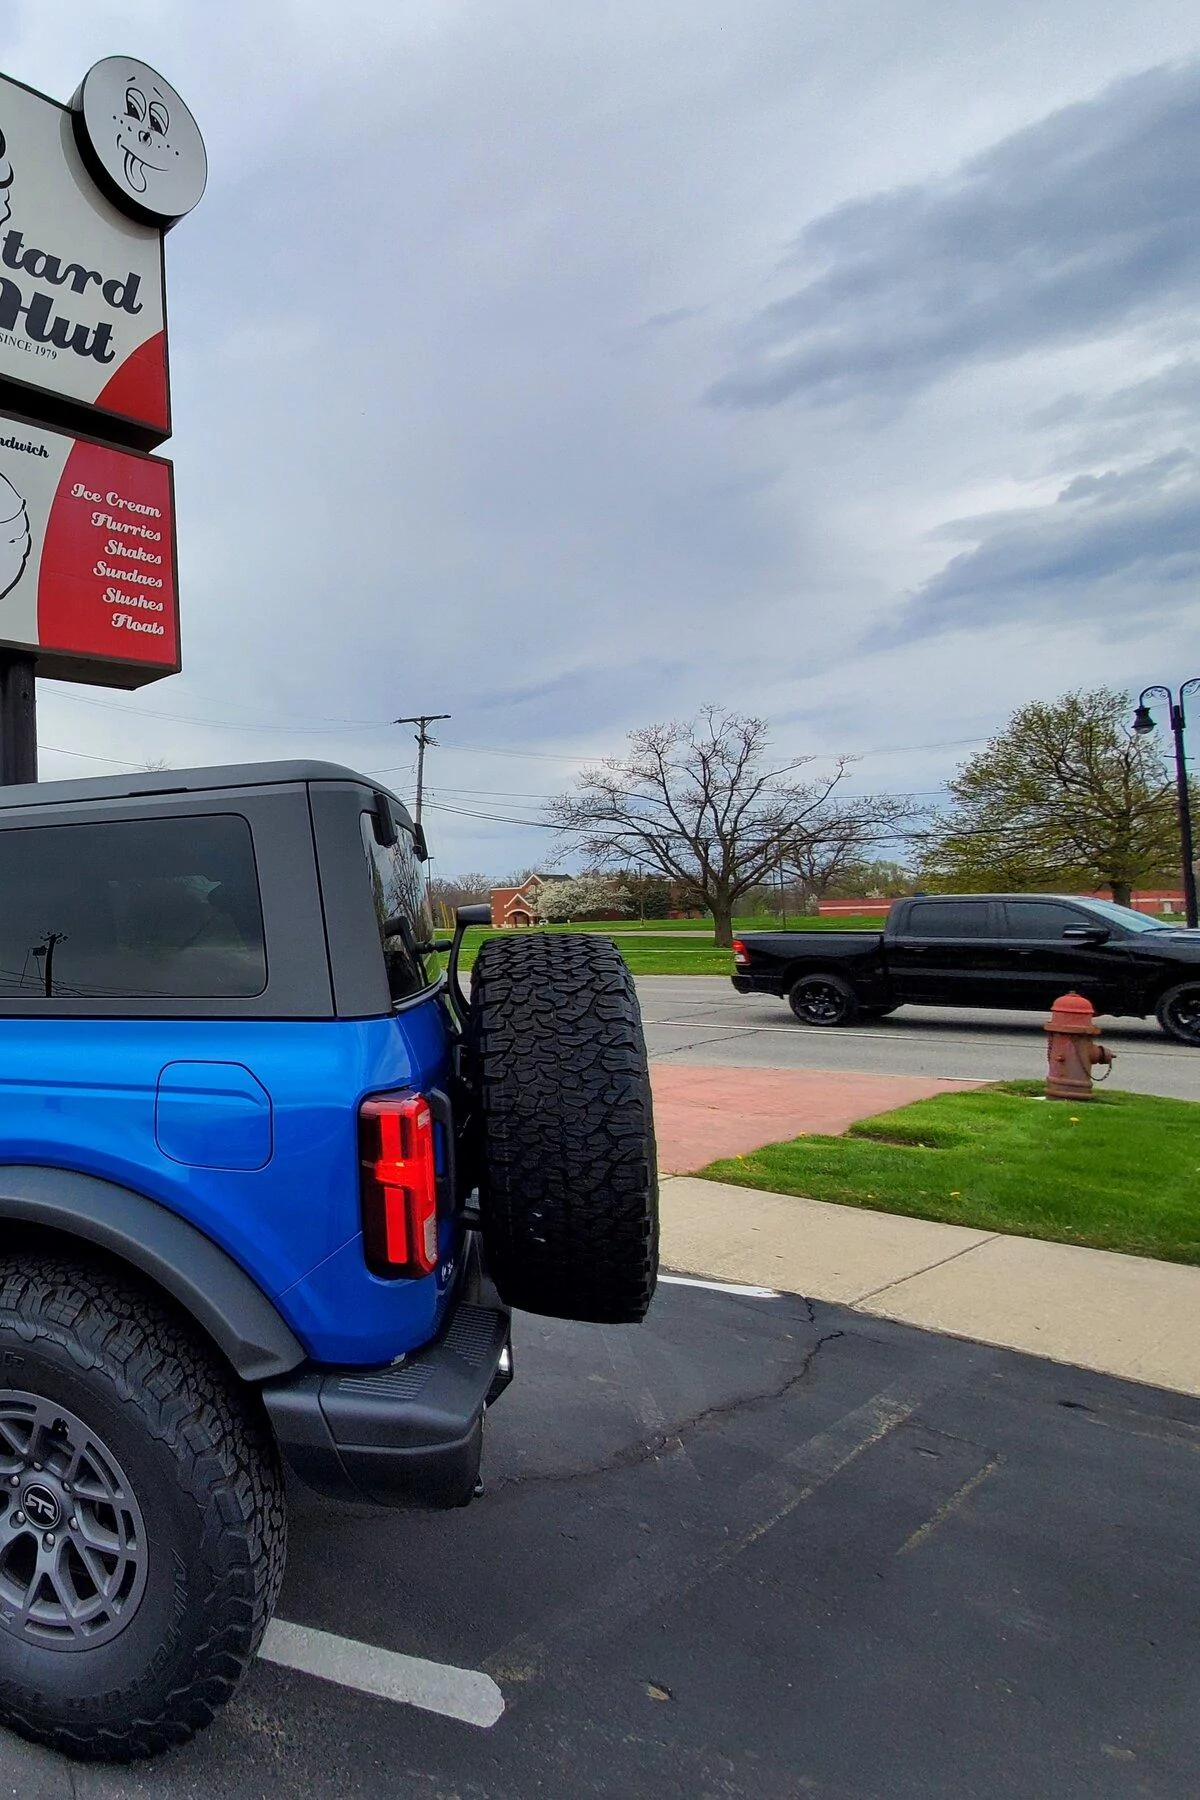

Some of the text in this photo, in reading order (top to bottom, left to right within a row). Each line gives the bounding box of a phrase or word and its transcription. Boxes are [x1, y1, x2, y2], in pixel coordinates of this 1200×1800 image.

[35, 345, 58, 360] 1979
[70, 483, 161, 518] Ice Cream
[90, 511, 161, 541] Flurries
[104, 539, 162, 564] Shakes
[92, 560, 163, 588] Sundaes
[102, 587, 164, 612] Slushes
[111, 612, 165, 635] Floats
